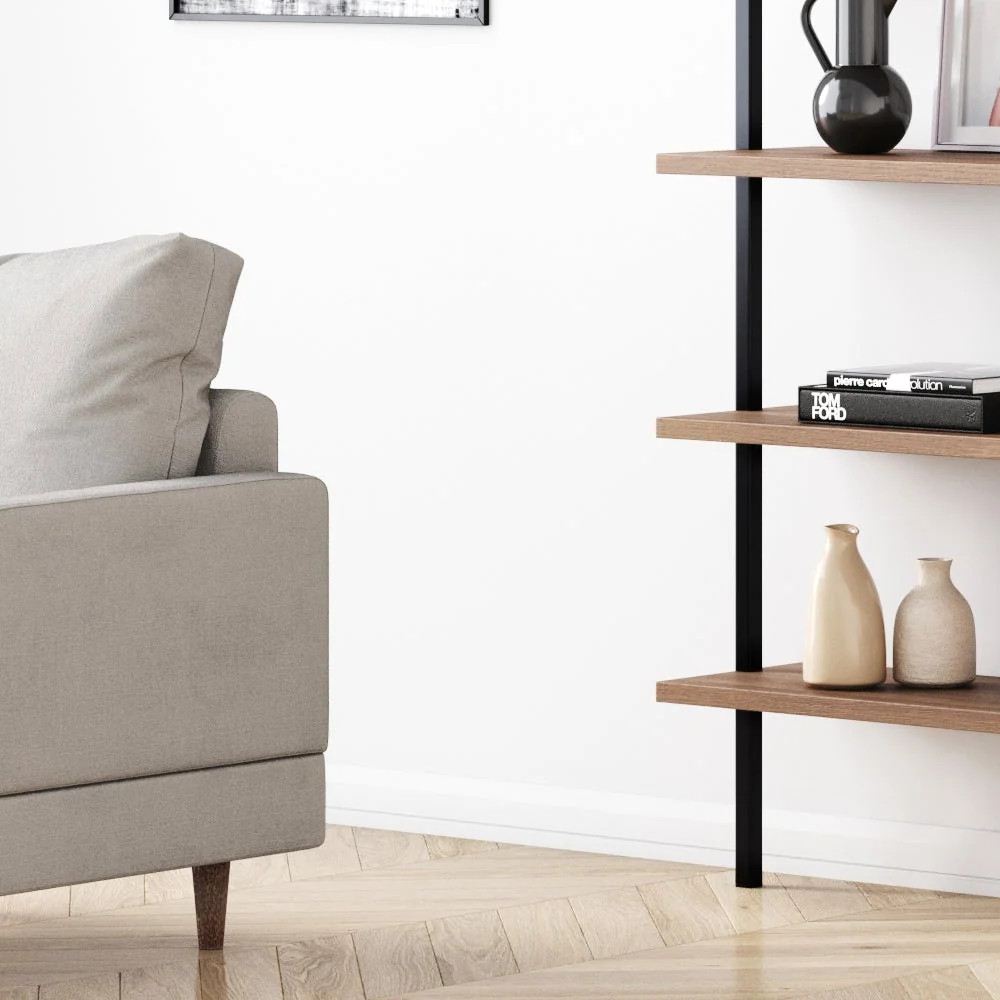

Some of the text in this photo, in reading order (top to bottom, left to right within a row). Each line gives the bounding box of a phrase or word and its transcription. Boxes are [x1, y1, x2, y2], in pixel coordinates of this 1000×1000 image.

[833, 374, 864, 387] pierre
[911, 379, 943, 391] olution
[811, 392, 841, 408] TOM
[811, 406, 847, 421] FORD
